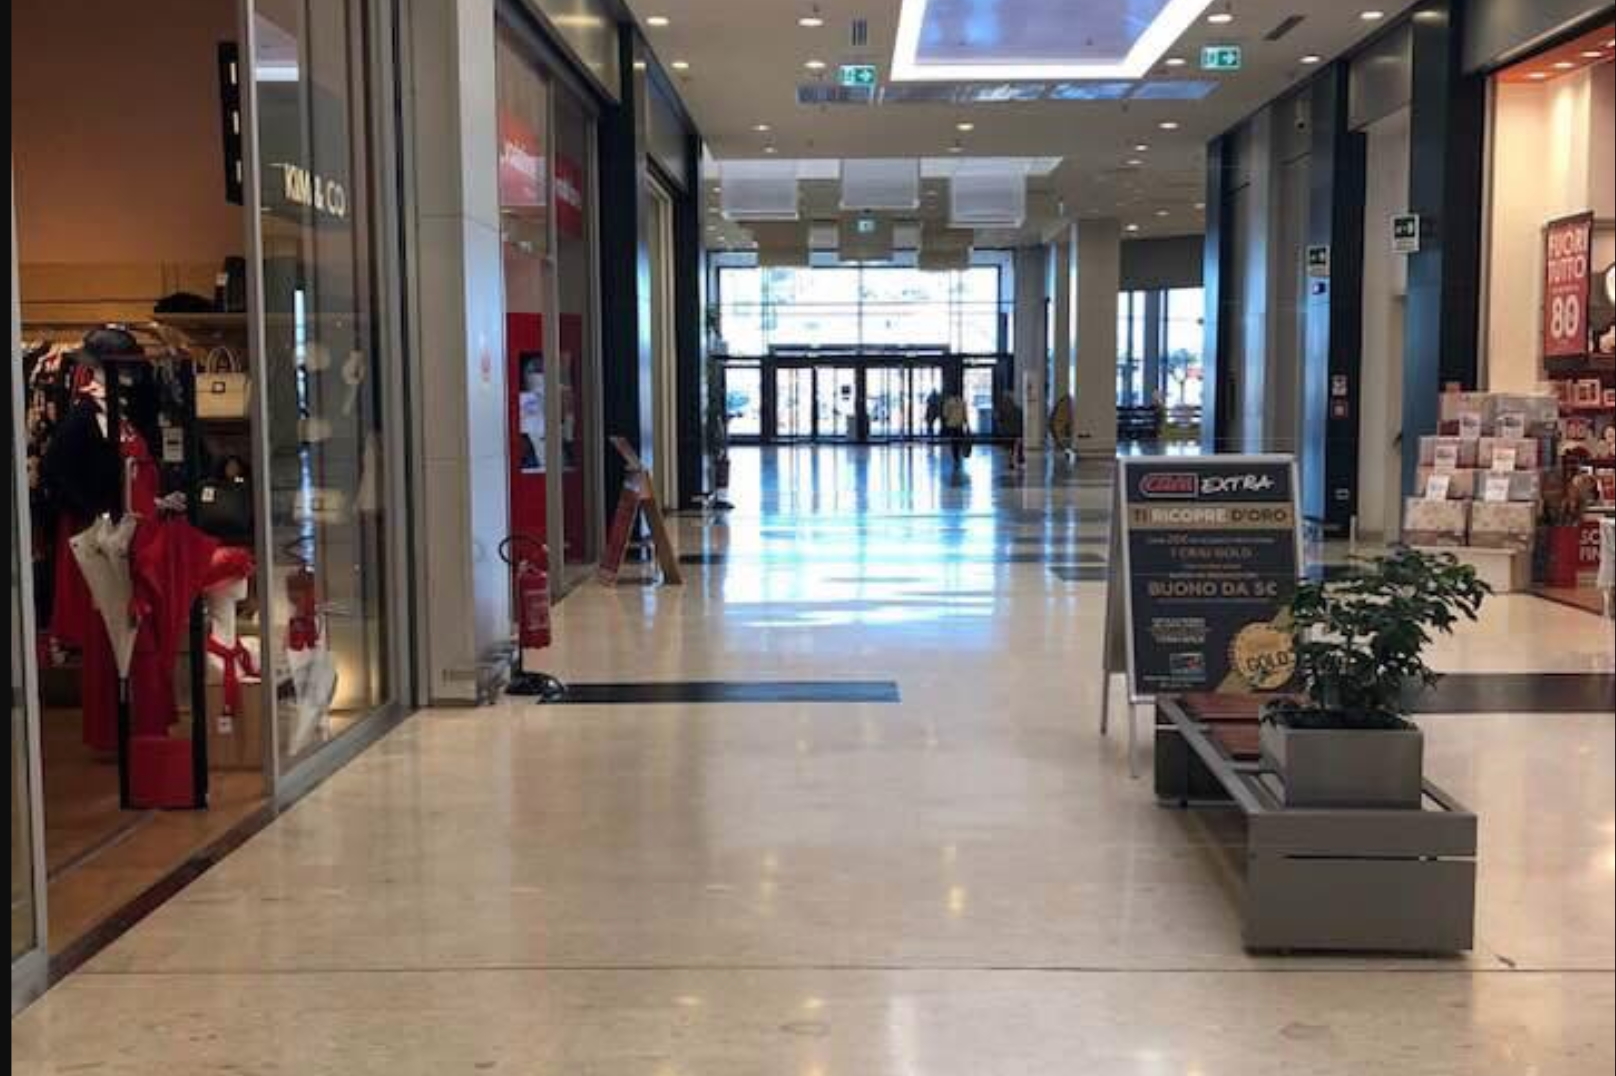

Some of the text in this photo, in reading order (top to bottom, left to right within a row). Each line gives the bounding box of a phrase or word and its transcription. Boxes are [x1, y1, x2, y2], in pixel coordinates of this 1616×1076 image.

[1201, 474, 1275, 494] EXTRA
[1151, 508, 1227, 524] RICOPRE
[1231, 508, 1287, 524] D'ORO
[1149, 581, 1218, 597] BUONO
[1222, 581, 1250, 597] DA
[1246, 650, 1289, 672] GOLD
